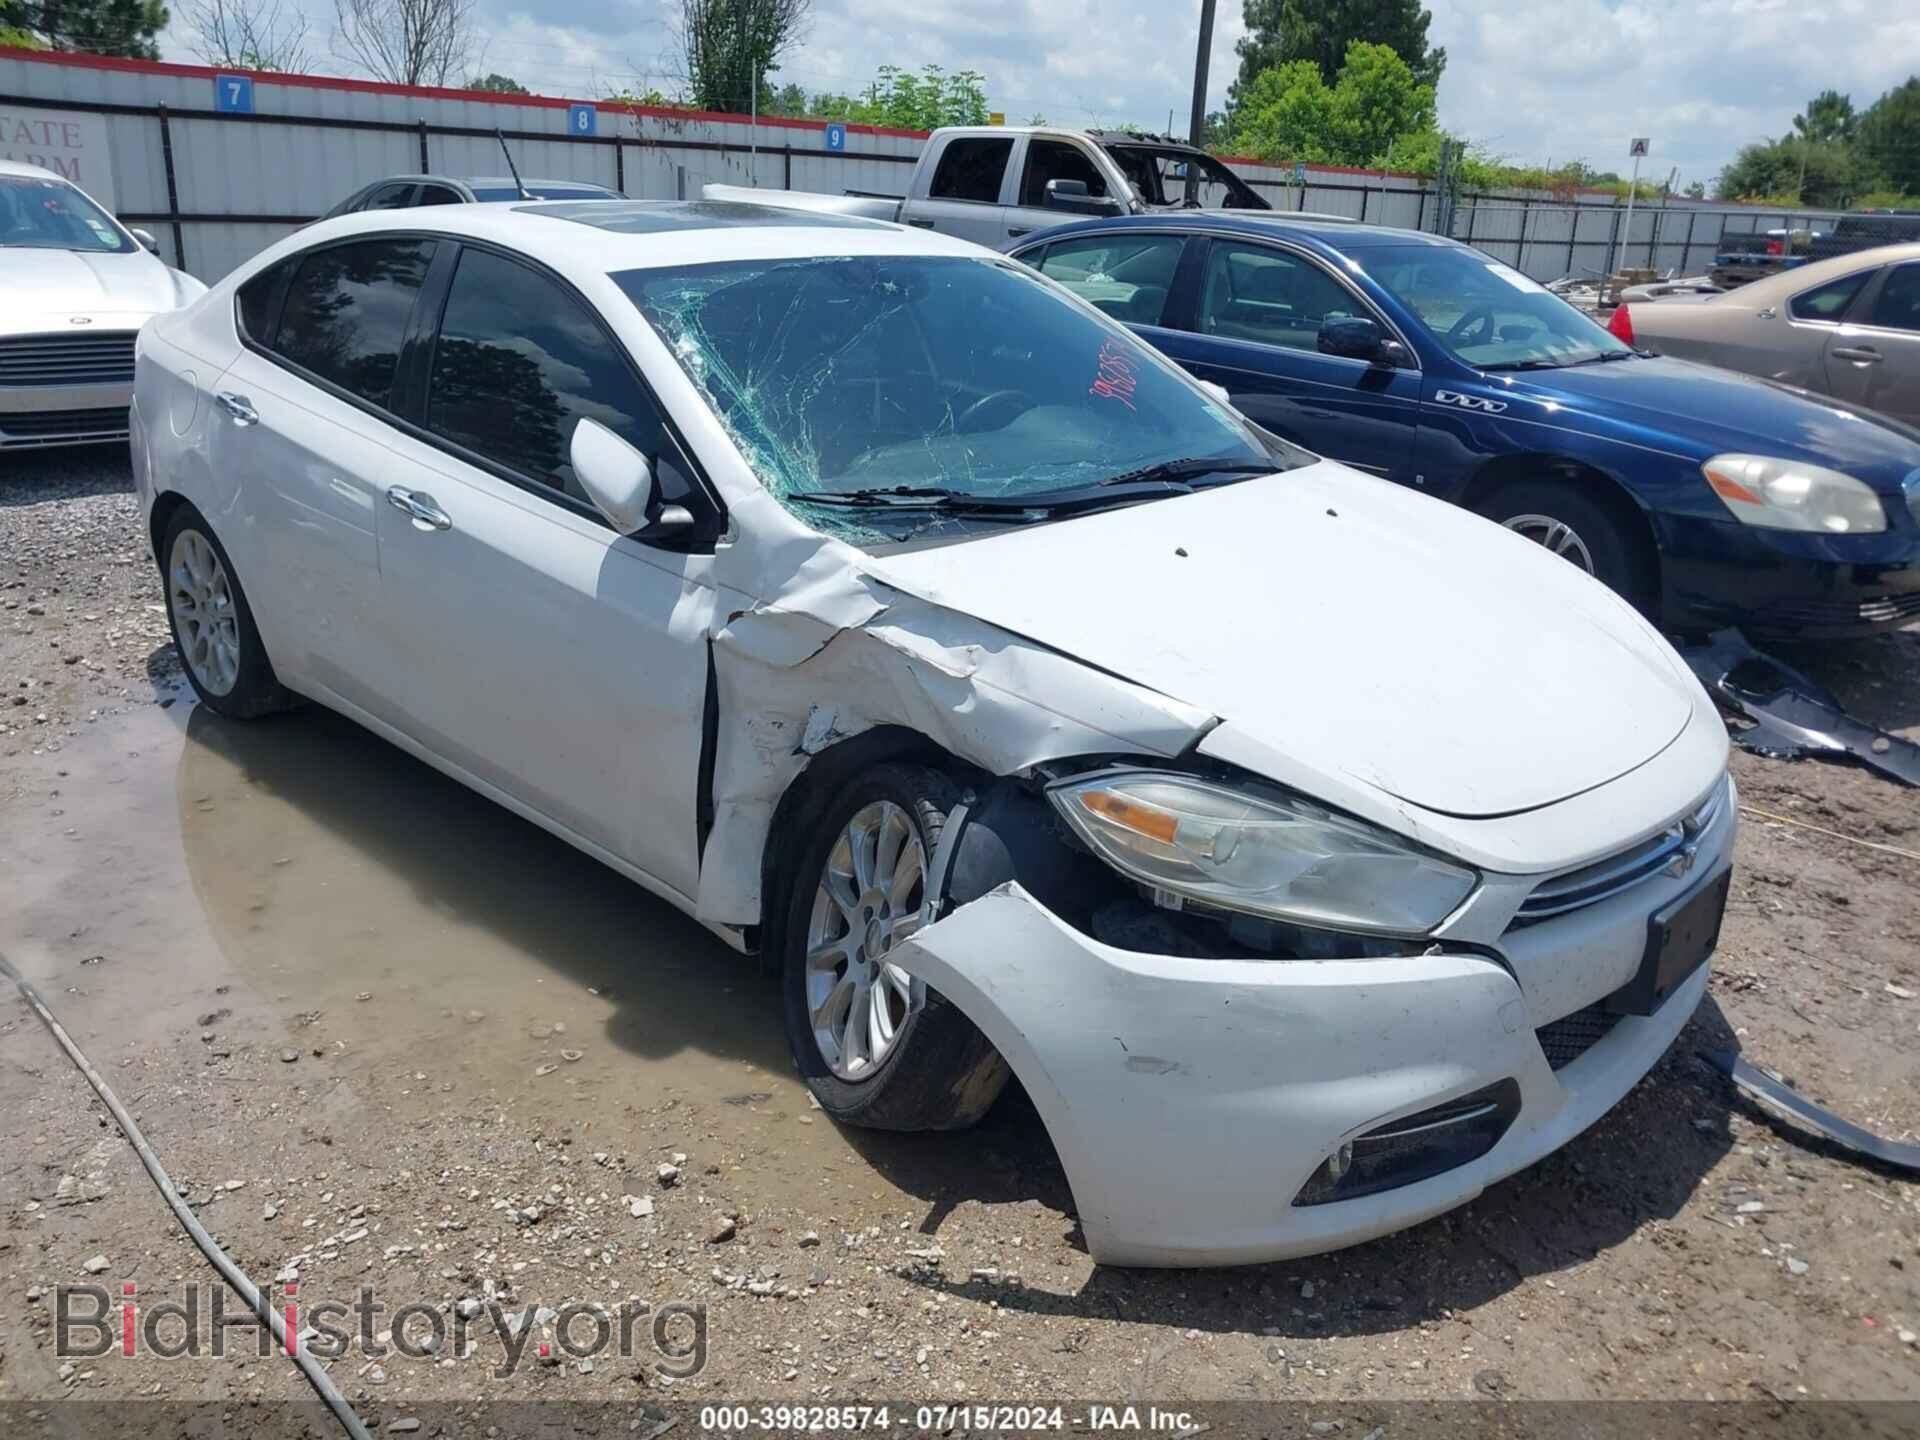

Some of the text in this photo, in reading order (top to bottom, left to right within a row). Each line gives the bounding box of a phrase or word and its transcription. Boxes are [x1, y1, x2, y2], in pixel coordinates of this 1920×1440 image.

[228, 82, 241, 105] 7
[578, 111, 588, 130] 8
[831, 129, 840, 147] 9
[1634, 141, 1645, 153] A
